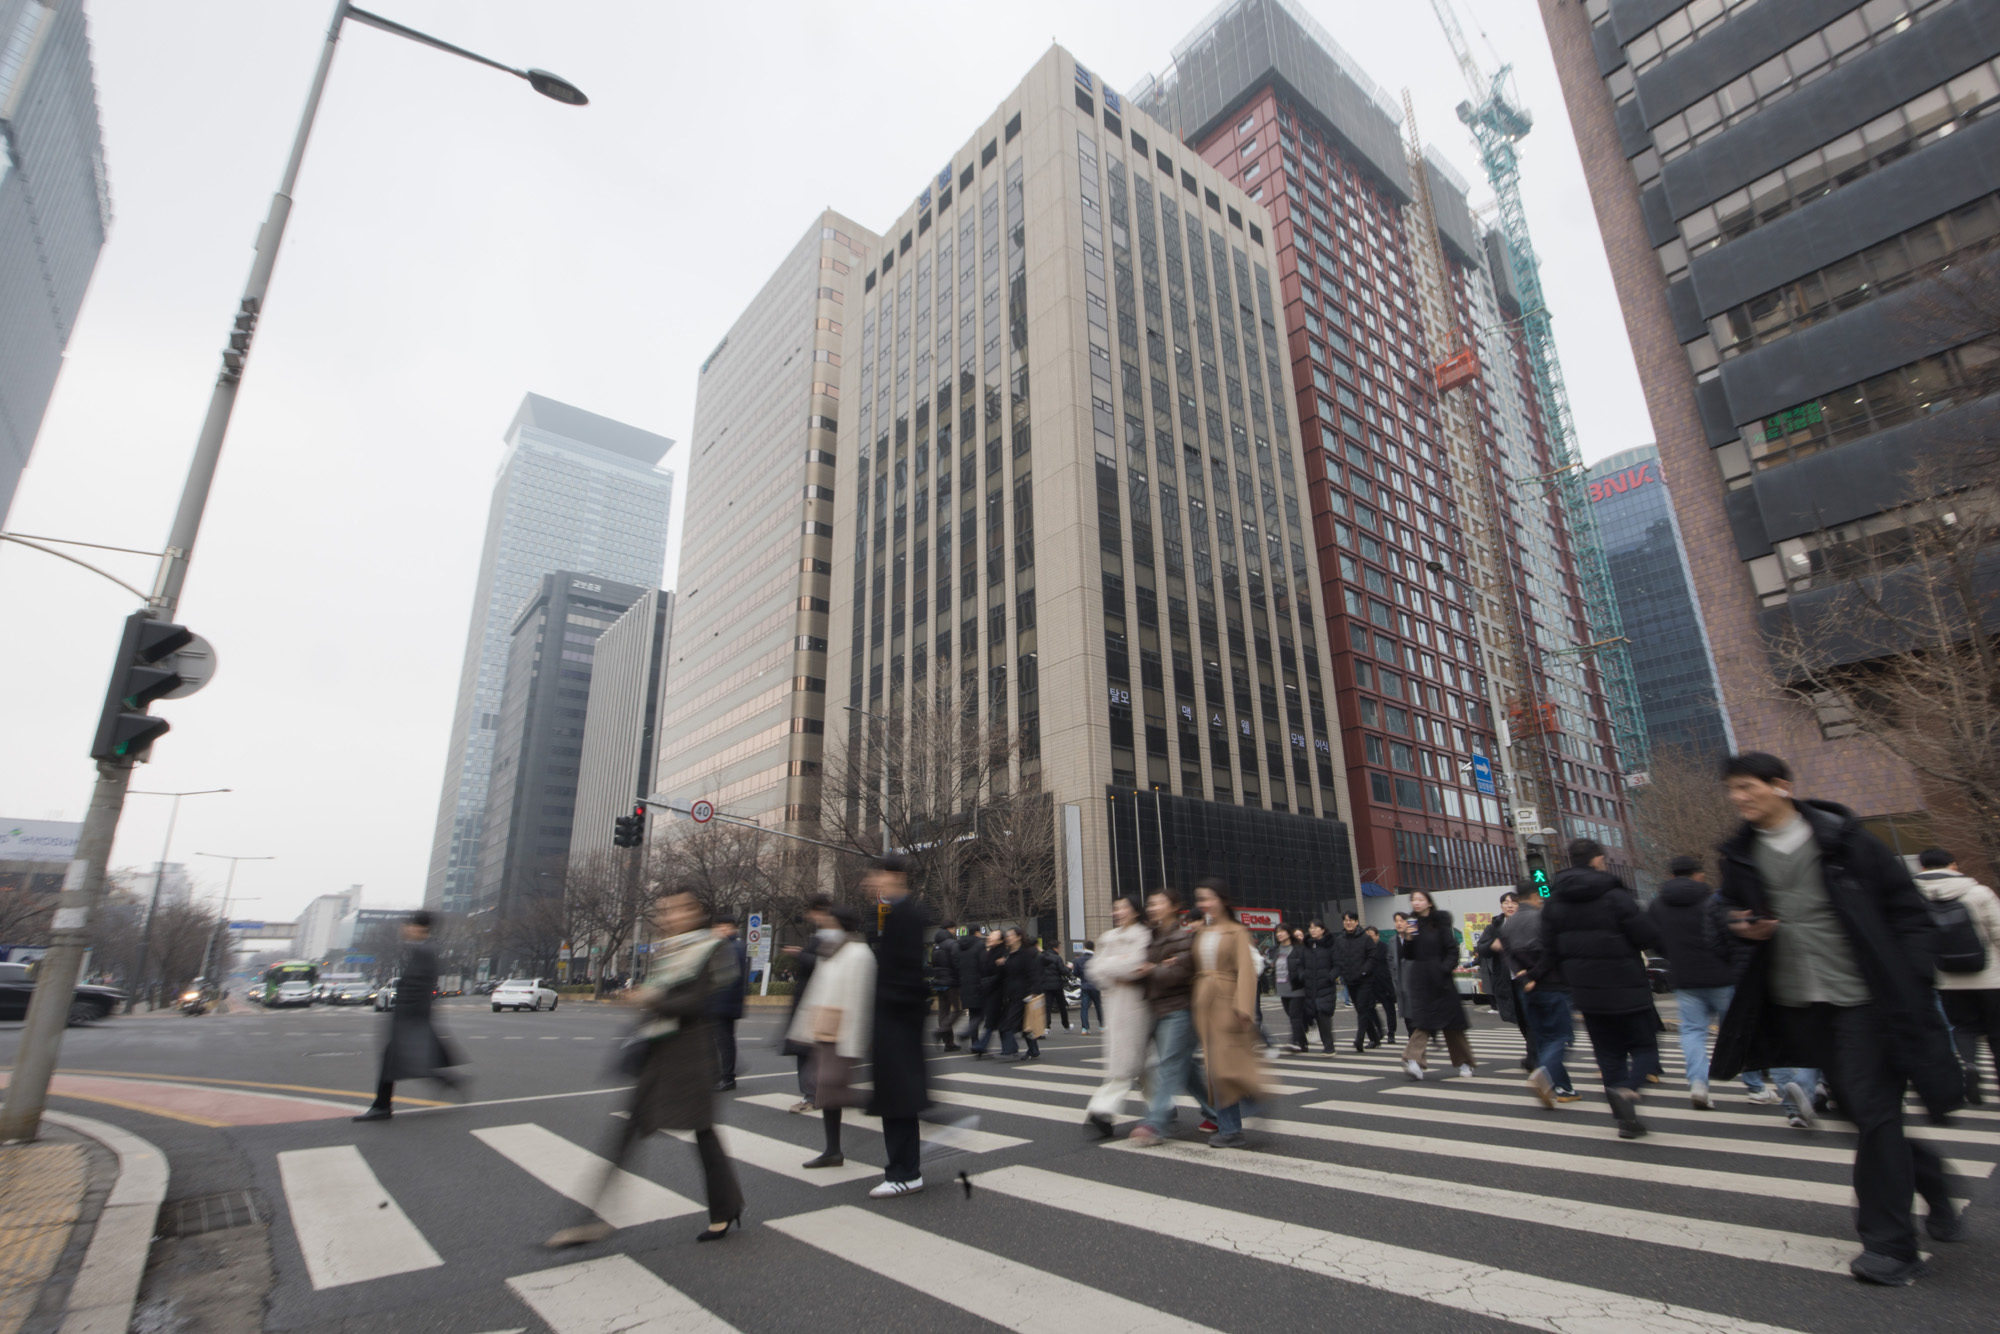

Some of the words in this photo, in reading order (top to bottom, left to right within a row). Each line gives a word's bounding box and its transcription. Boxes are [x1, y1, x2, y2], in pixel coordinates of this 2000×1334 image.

[1585, 464, 1654, 503] BNK
[1110, 687, 1130, 704] 탈모
[1291, 732, 1305, 748] 모발
[1315, 739, 1329, 753] 이식
[696, 806, 710, 817] 40
[1538, 885, 1551, 898] 13
